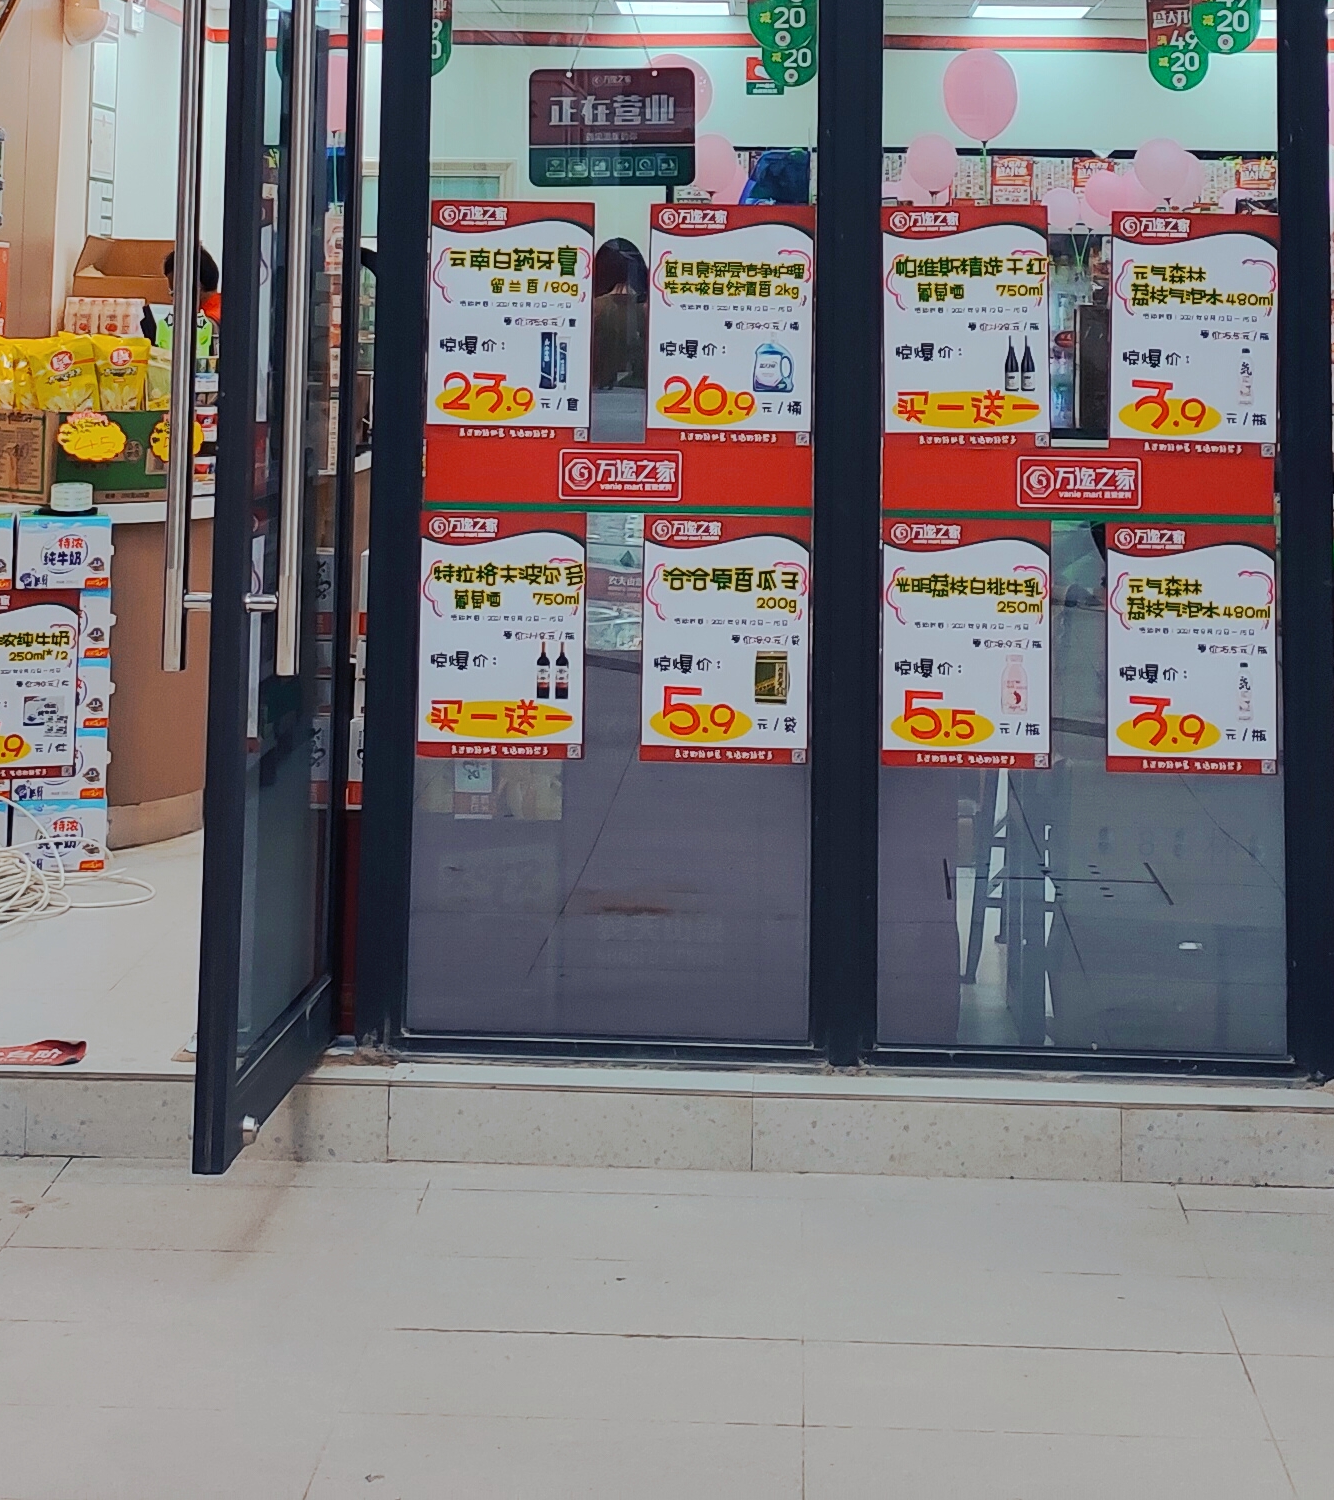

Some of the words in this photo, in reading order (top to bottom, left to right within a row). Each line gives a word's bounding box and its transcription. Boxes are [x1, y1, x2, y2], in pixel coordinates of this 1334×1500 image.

[1153, 11, 1191, 28] 盛大开
[549, 95, 675, 126] 正在营业
[459, 207, 507, 221] 万逸之家
[679, 209, 727, 224] 万逸之家
[910, 212, 960, 227] 万逸之家
[1140, 217, 1191, 233] 万逸之家
[450, 246, 578, 276] 云南白药牙膏
[1133, 264, 1206, 284] 元气森林
[774, 281, 800, 299] 2kg
[996, 283, 1043, 297] 750ml
[1226, 292, 1273, 307] 480ml
[442, 372, 534, 414] 23.9
[663, 375, 755, 416] 26.9
[898, 390, 1040, 425] 买一送一
[1132, 379, 1207, 429] 3.9
[597, 460, 676, 482] 万逸之家
[1055, 466, 1135, 490] 万逸之家
[449, 518, 498, 533] 万逸之家
[672, 521, 721, 536] 万逸之家
[910, 525, 961, 539] 万逸之家
[58, 538, 83, 549] 特浓
[1135, 530, 1185, 544] 万逸之家
[44, 552, 82, 566] 纯牛奶
[1128, 576, 1202, 596] 元气森林
[533, 592, 580, 606] 750ml
[756, 597, 797, 613] 200g
[997, 600, 1043, 614] 250ml
[1223, 605, 1270, 619] 480ml
[431, 700, 572, 735] 买一送一
[662, 686, 735, 736] 5.9
[904, 690, 975, 740] 5.5
[1129, 696, 1205, 746] 3.9
[53, 820, 79, 832] 特浓
